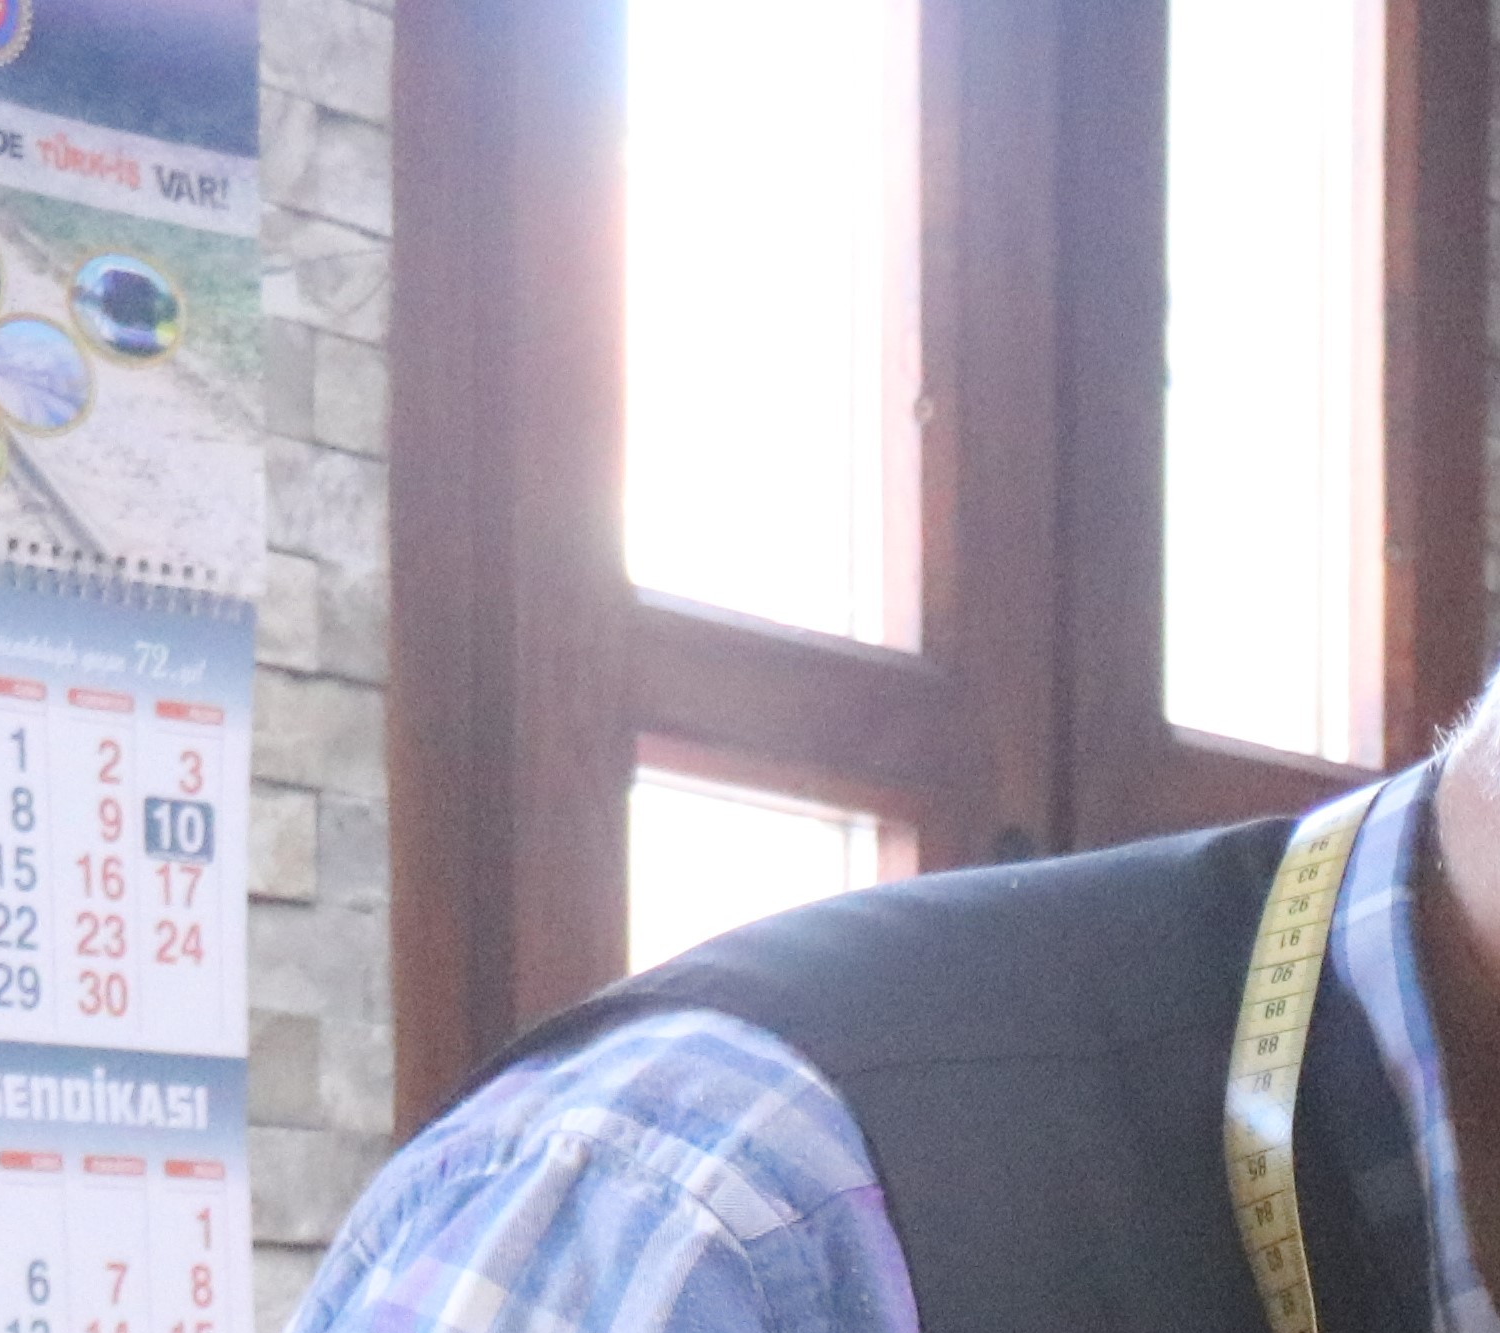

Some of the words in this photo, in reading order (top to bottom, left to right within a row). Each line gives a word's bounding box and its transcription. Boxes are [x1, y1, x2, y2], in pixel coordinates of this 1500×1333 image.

[155, 162, 230, 210] VAR!
[11, 728, 26, 771] 1
[99, 739, 121, 784] 2
[179, 750, 203, 796] 3
[11, 786, 35, 832] 8
[99, 797, 122, 843] 9
[154, 803, 203, 853] 10
[77, 854, 125, 901] 16
[154, 858, 208, 907] 17
[77, 911, 126, 959] 23
[156, 920, 204, 964] 24
[79, 970, 128, 1017] 30
[197, 1208, 211, 1248] 1
[27, 1260, 50, 1305] 6
[107, 1262, 128, 1304] 7
[191, 1264, 213, 1308] 8
